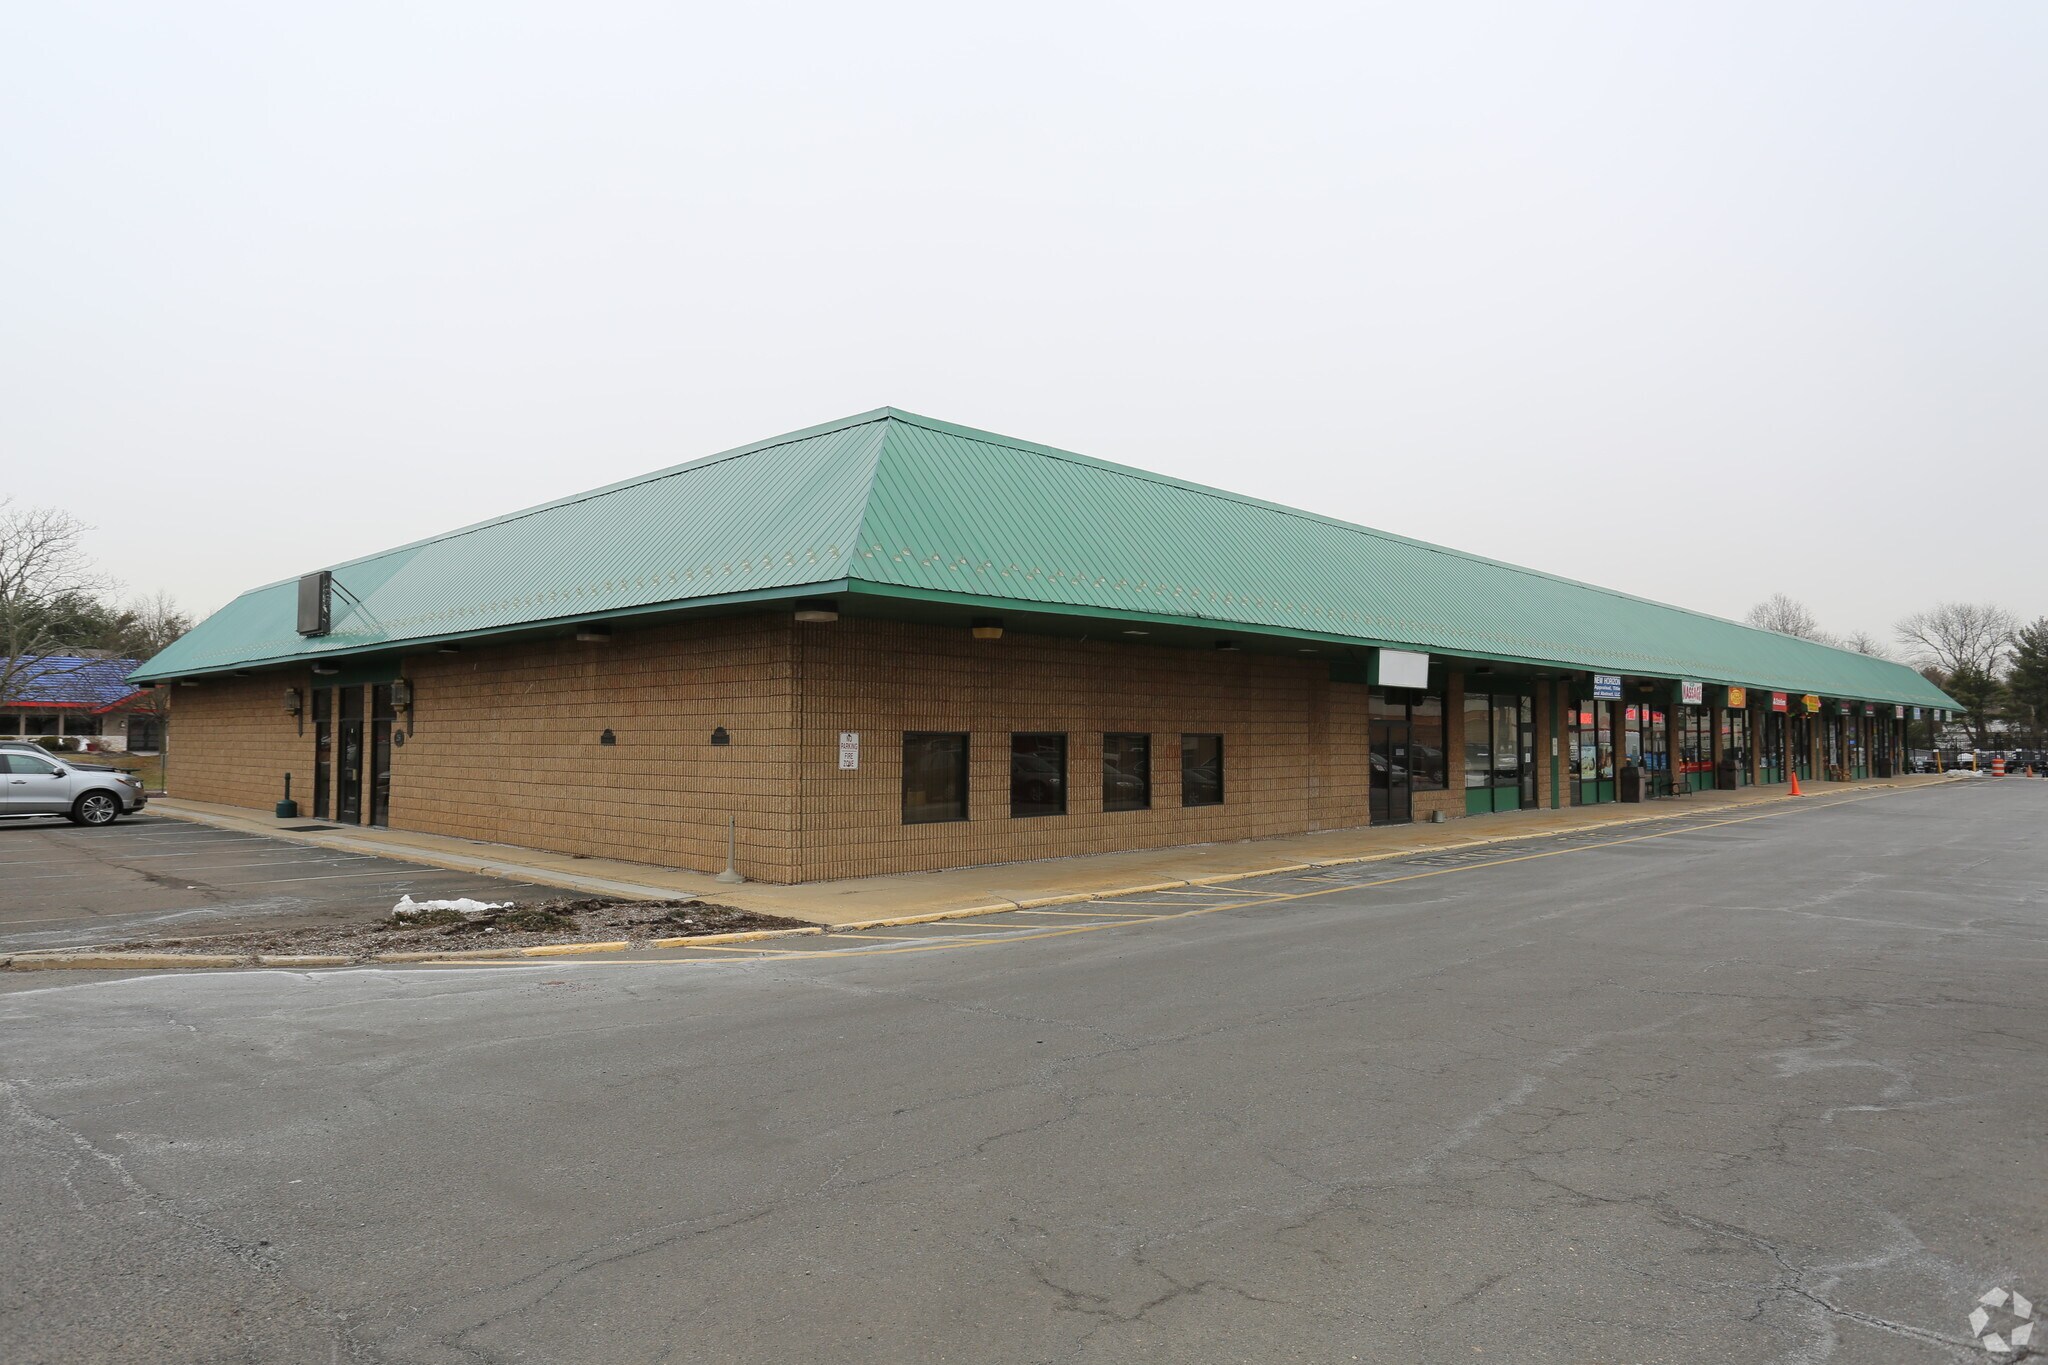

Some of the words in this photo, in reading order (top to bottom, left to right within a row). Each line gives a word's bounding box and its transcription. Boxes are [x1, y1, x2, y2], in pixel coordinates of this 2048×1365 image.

[1594, 676, 1603, 684] NEW
[1603, 677, 1621, 685] HORIZON
[1683, 685, 1702, 701] MASSAGE
[847, 734, 852, 743] NO
[841, 742, 858, 750] PARKING
[844, 752, 854, 760] FIRE
